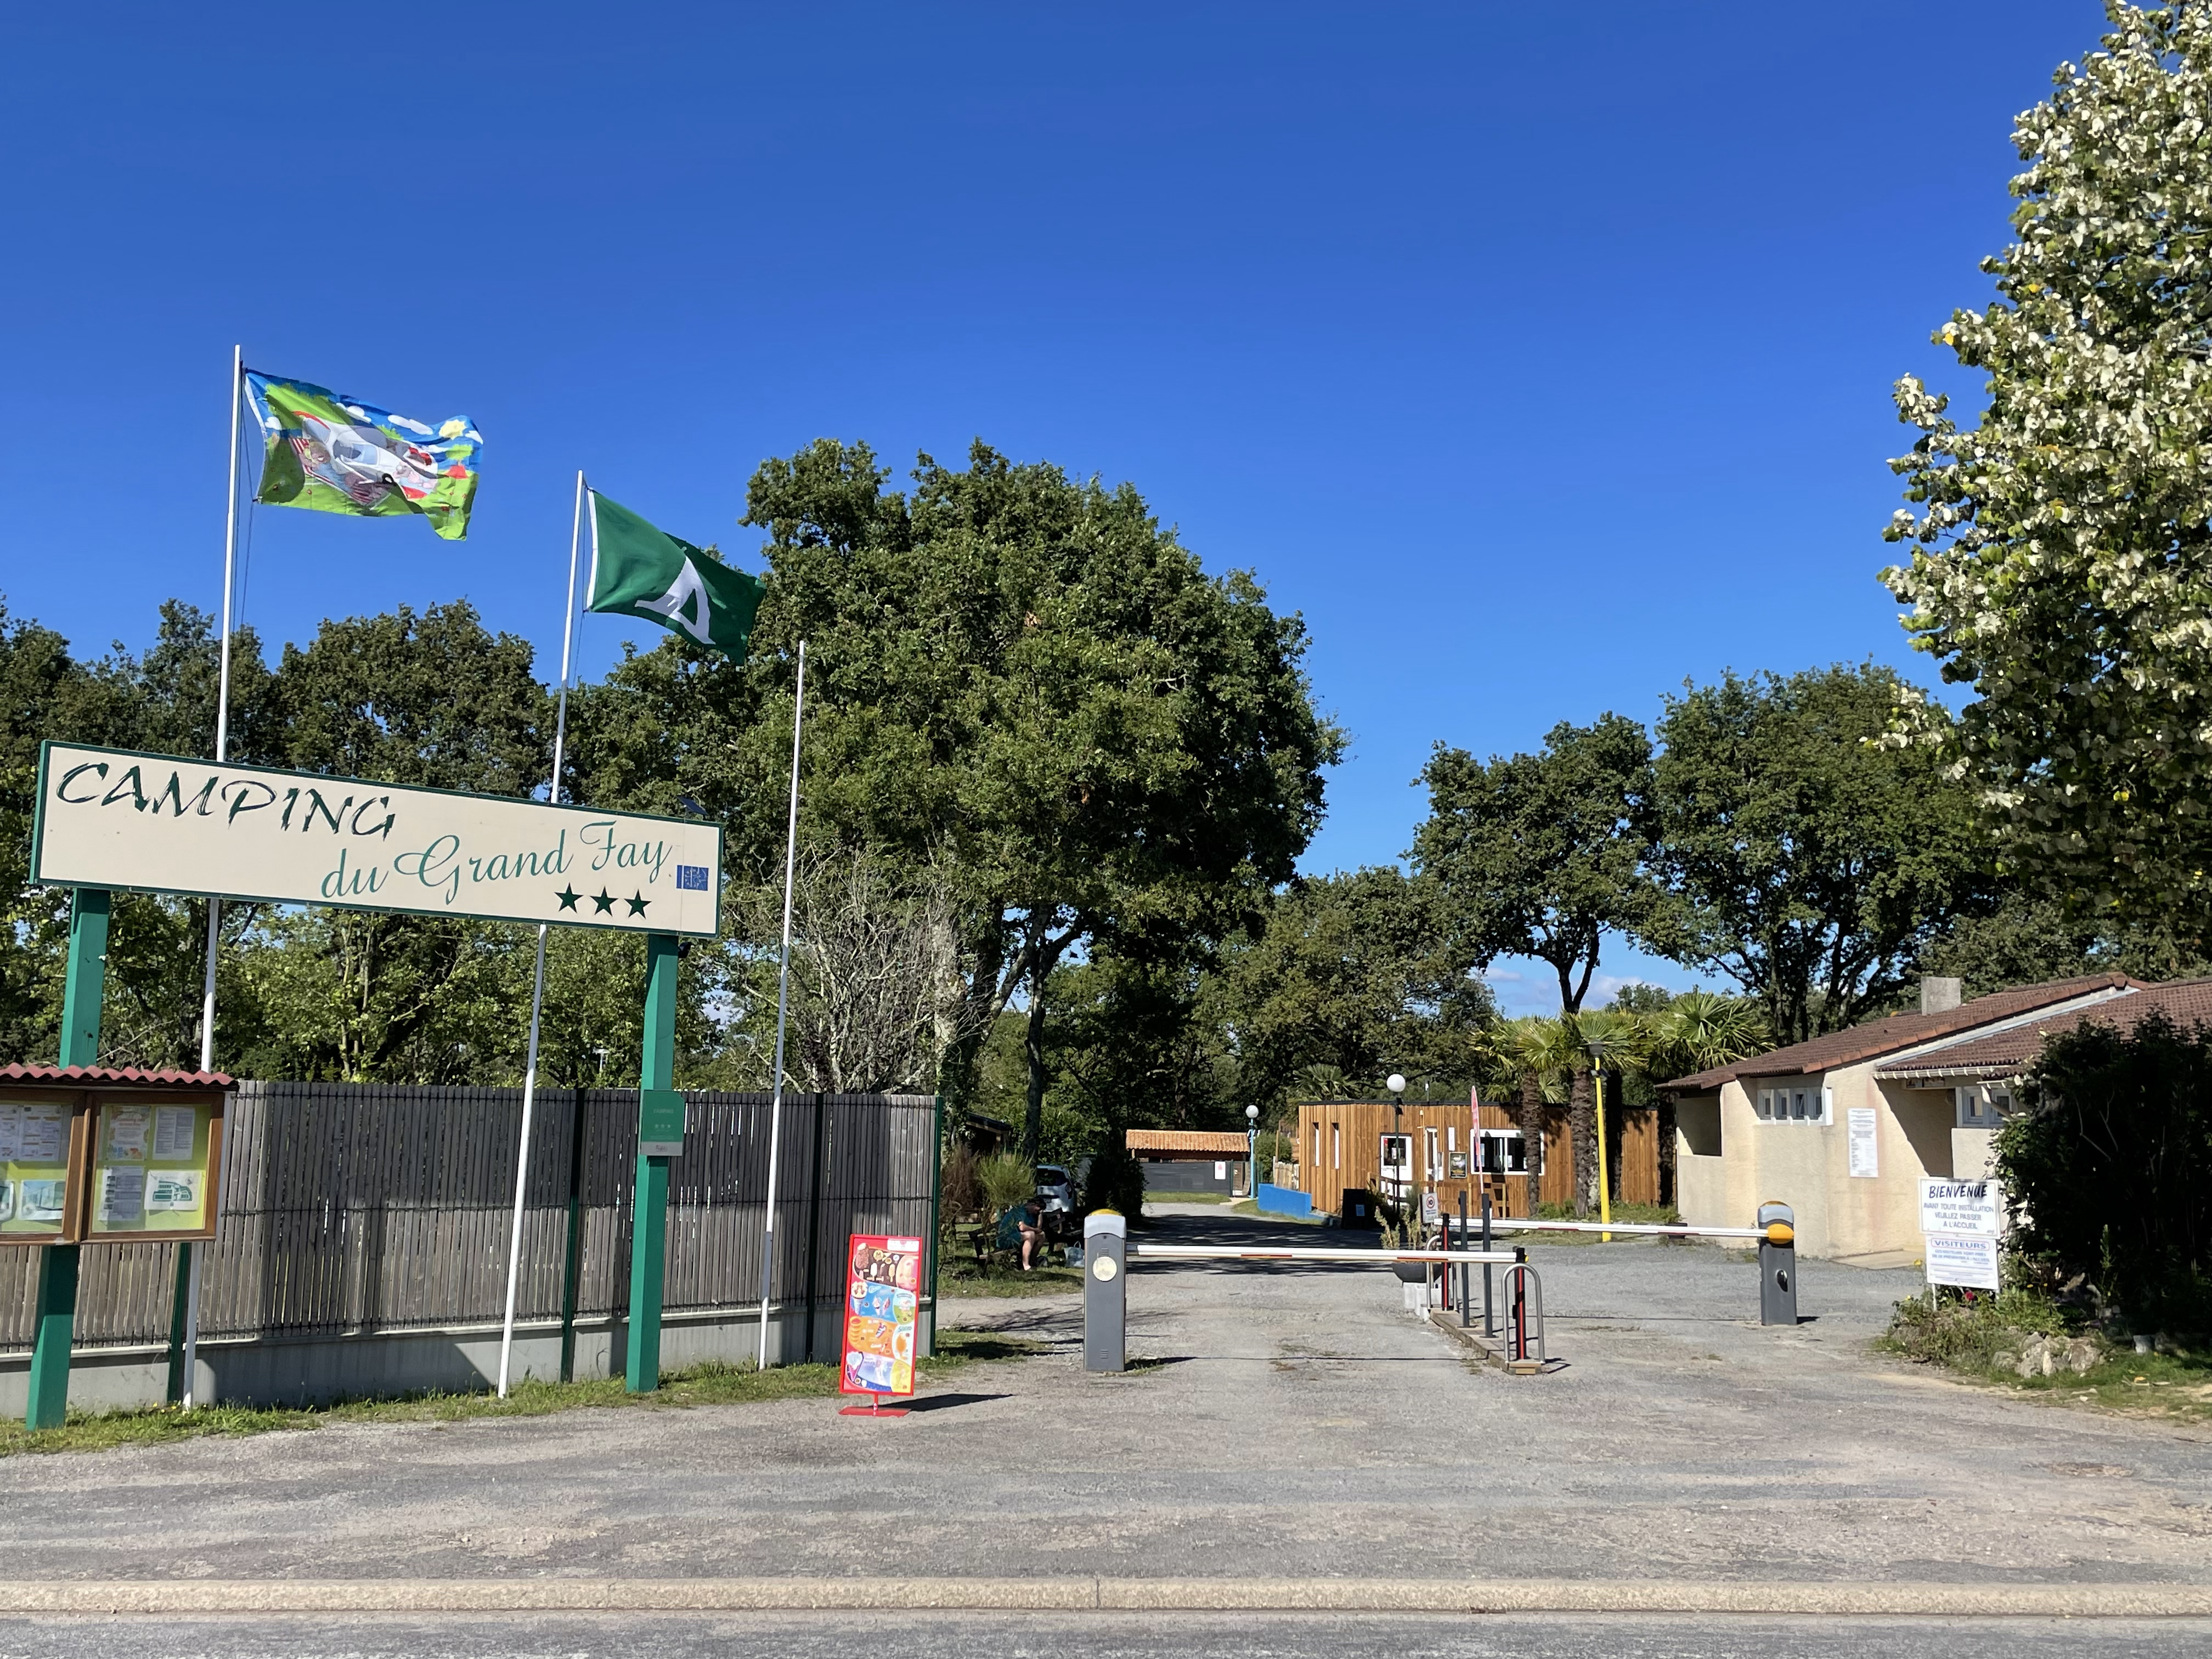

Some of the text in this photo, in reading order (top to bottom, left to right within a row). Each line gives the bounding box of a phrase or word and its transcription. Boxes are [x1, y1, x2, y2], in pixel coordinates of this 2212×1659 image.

[56, 762, 396, 841] CAMPING
[321, 820, 673, 905] du Grand Fay
[1929, 1185, 1988, 1198] BIENVENUE
[1949, 1221, 1978, 1229] L'ACCUEIL
